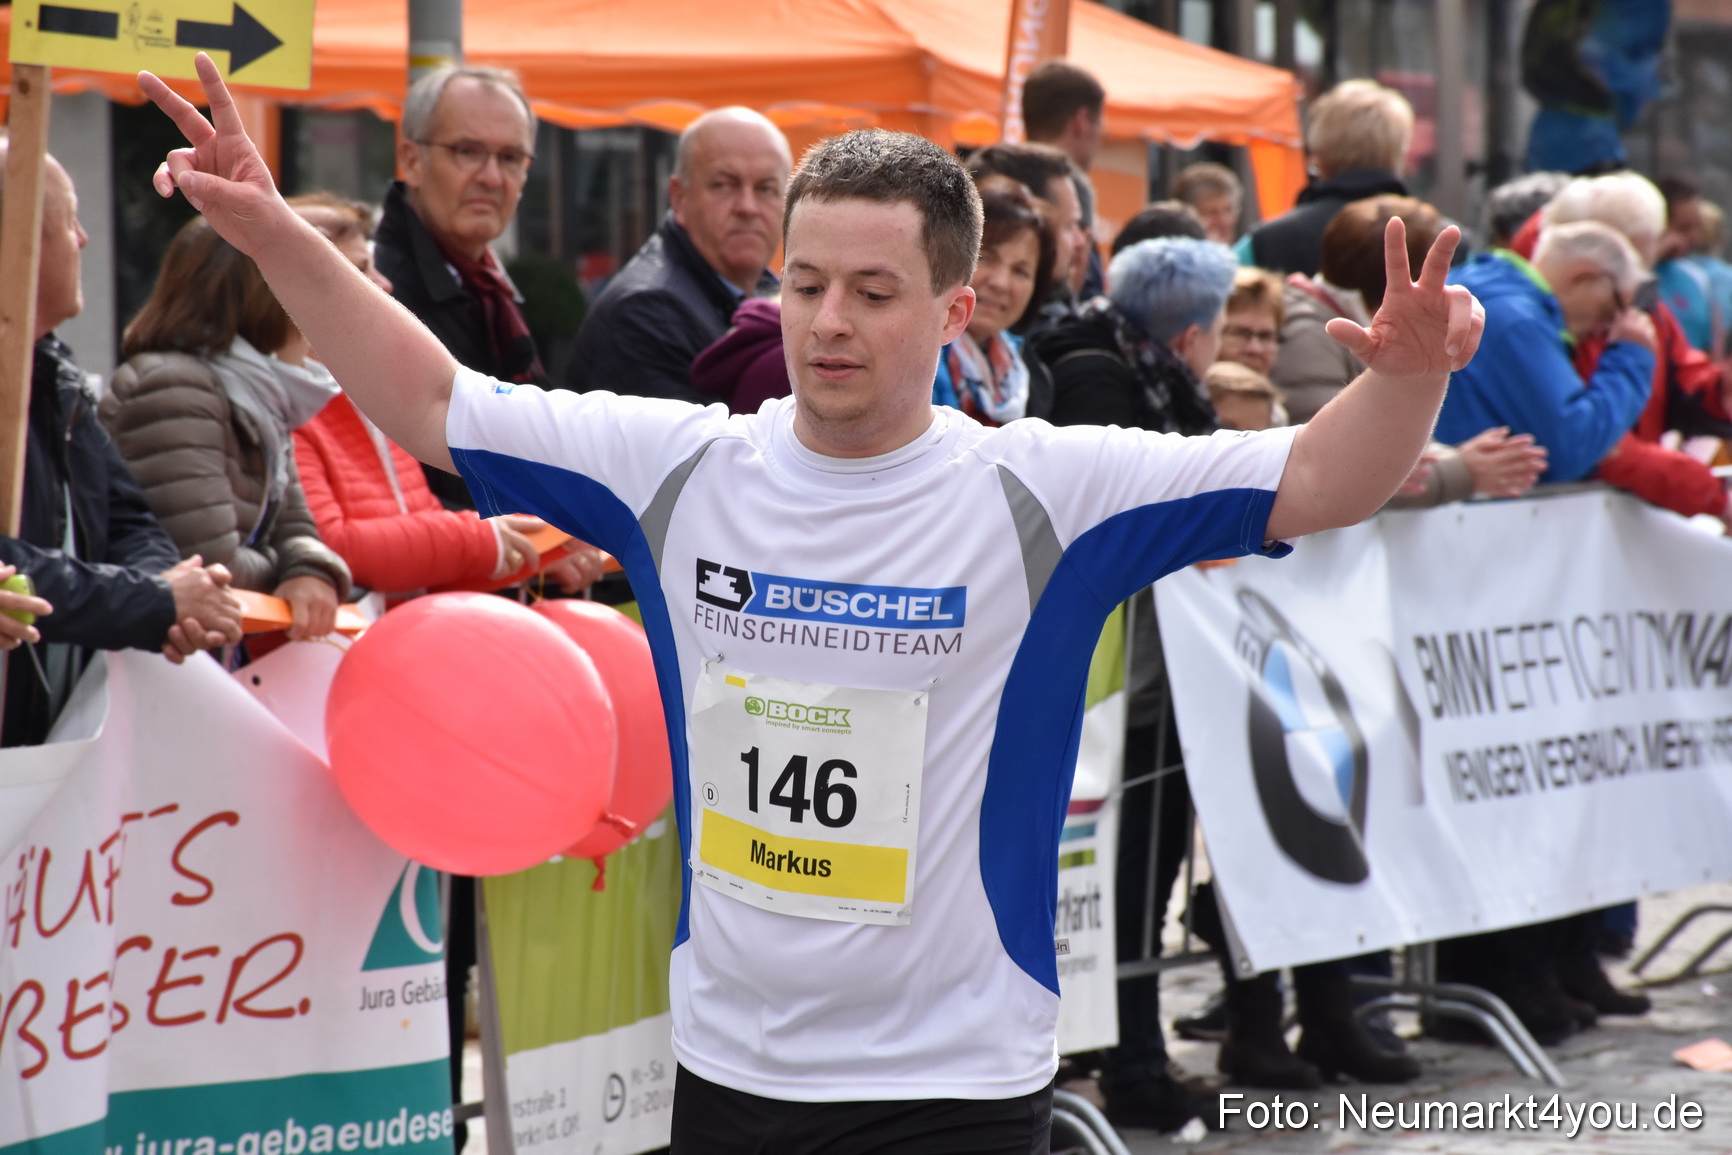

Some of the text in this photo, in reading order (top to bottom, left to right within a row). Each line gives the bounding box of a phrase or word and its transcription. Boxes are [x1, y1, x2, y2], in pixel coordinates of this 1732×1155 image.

[764, 582, 954, 622] BÜSCHEL
[694, 602, 963, 656] FEINSCHNEIDTEAM
[766, 699, 852, 728] BOCK
[766, 719, 852, 735] inspired by smart concepts
[706, 787, 714, 801] D
[740, 745, 858, 829] 146
[750, 838, 832, 878] Markus
[359, 976, 447, 1012] Jura Gebä
